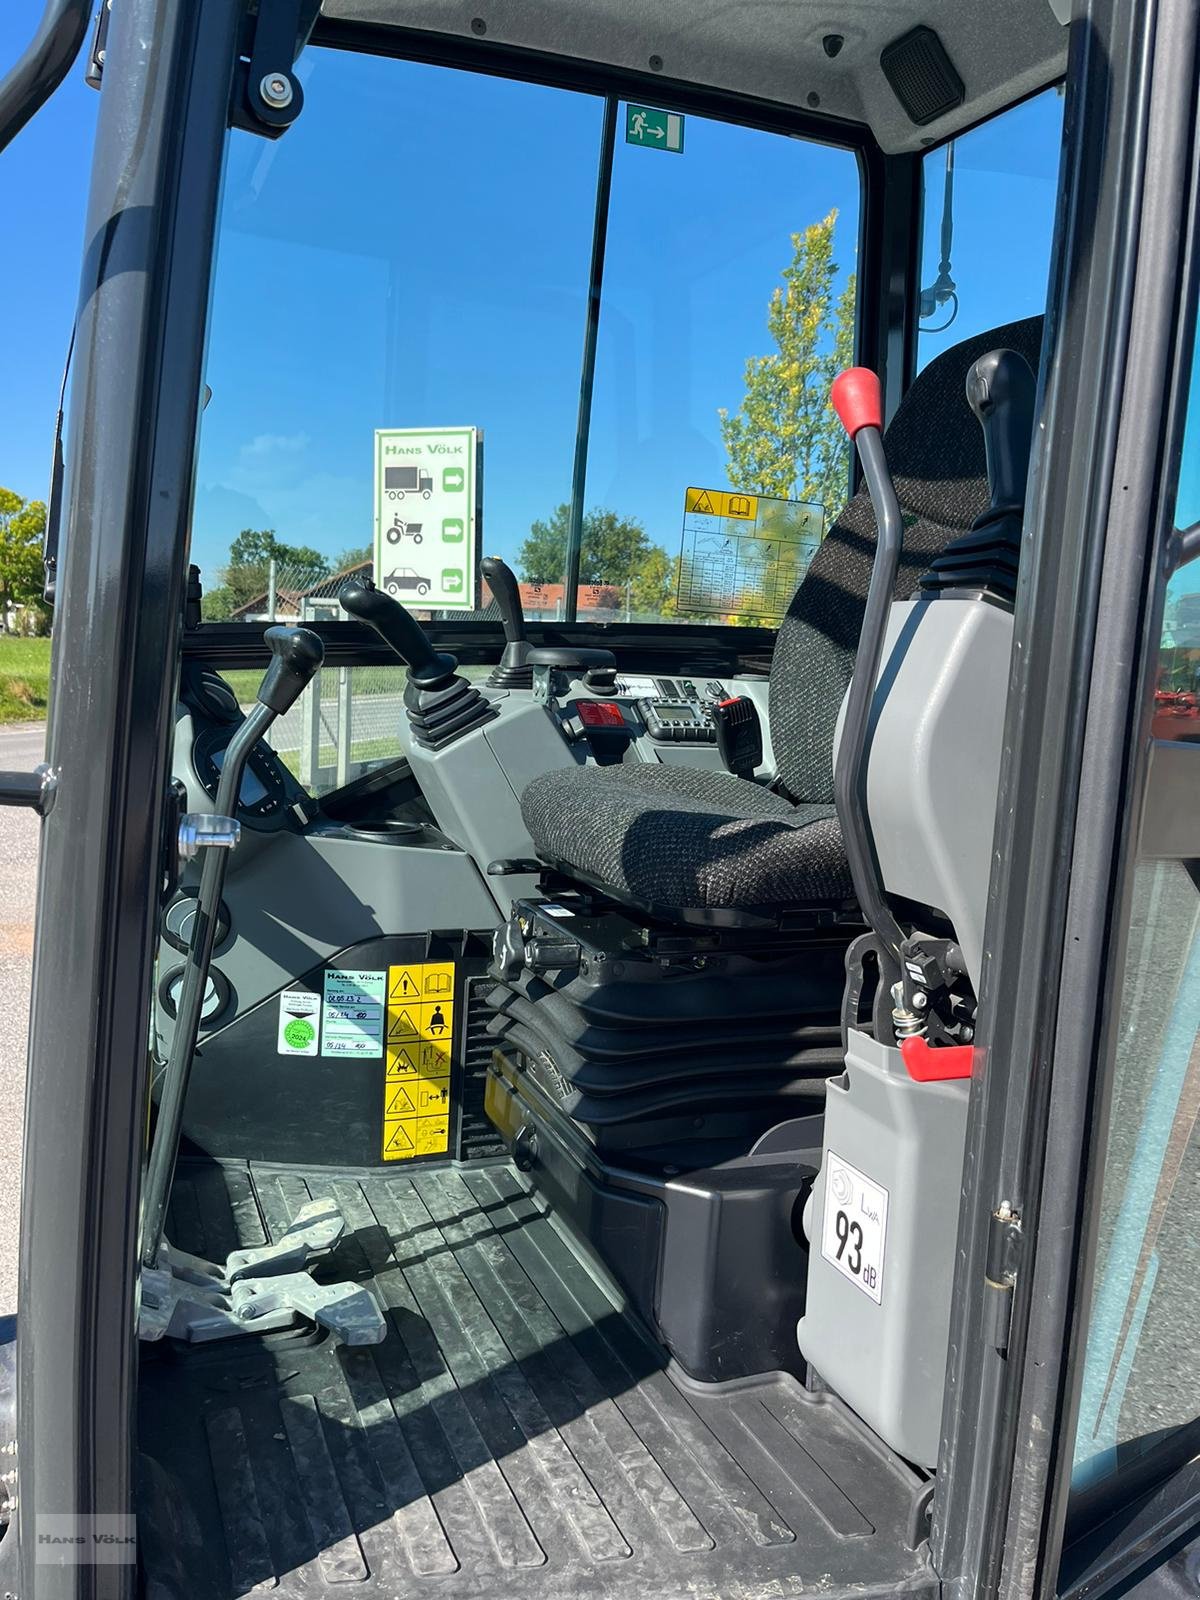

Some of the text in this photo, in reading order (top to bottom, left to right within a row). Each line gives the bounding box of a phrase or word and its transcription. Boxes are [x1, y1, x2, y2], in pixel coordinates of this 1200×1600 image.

[385, 444, 463, 455] HANS VÖLK
[291, 1033, 306, 1041] 2024
[836, 1210, 877, 1289] 93 dB
